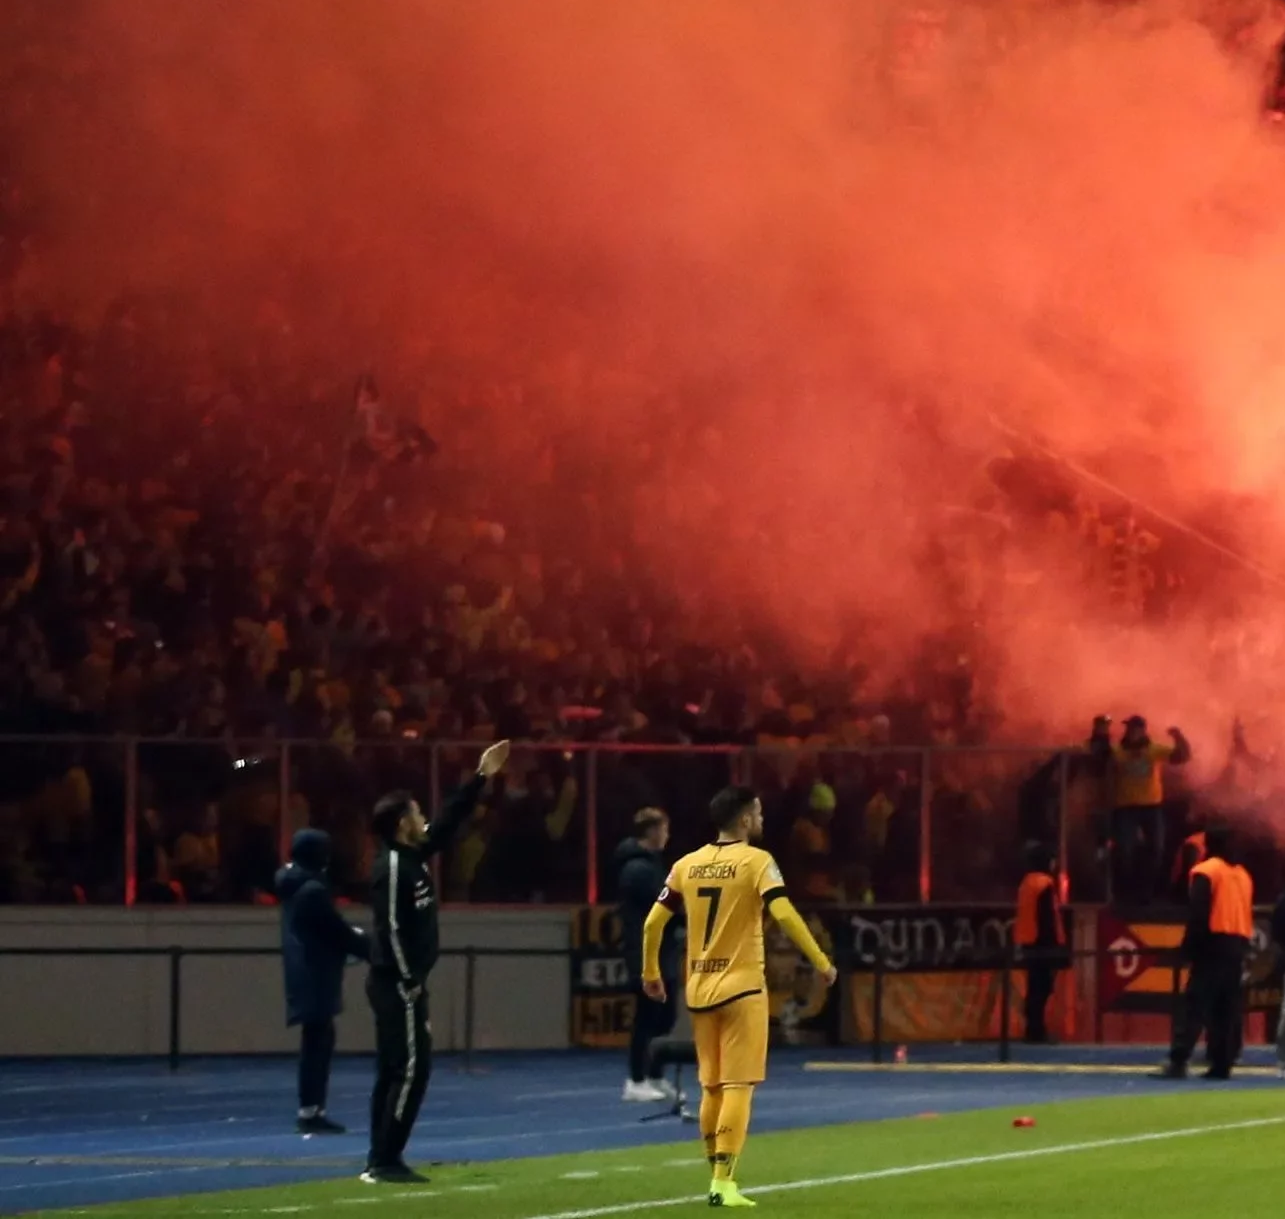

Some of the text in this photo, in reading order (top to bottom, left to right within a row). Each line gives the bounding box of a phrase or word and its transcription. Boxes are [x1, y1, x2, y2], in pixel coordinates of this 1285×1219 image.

[688, 864, 737, 879] DRESDEN
[697, 886, 723, 951] 7
[851, 914, 1025, 970] DYNAM
